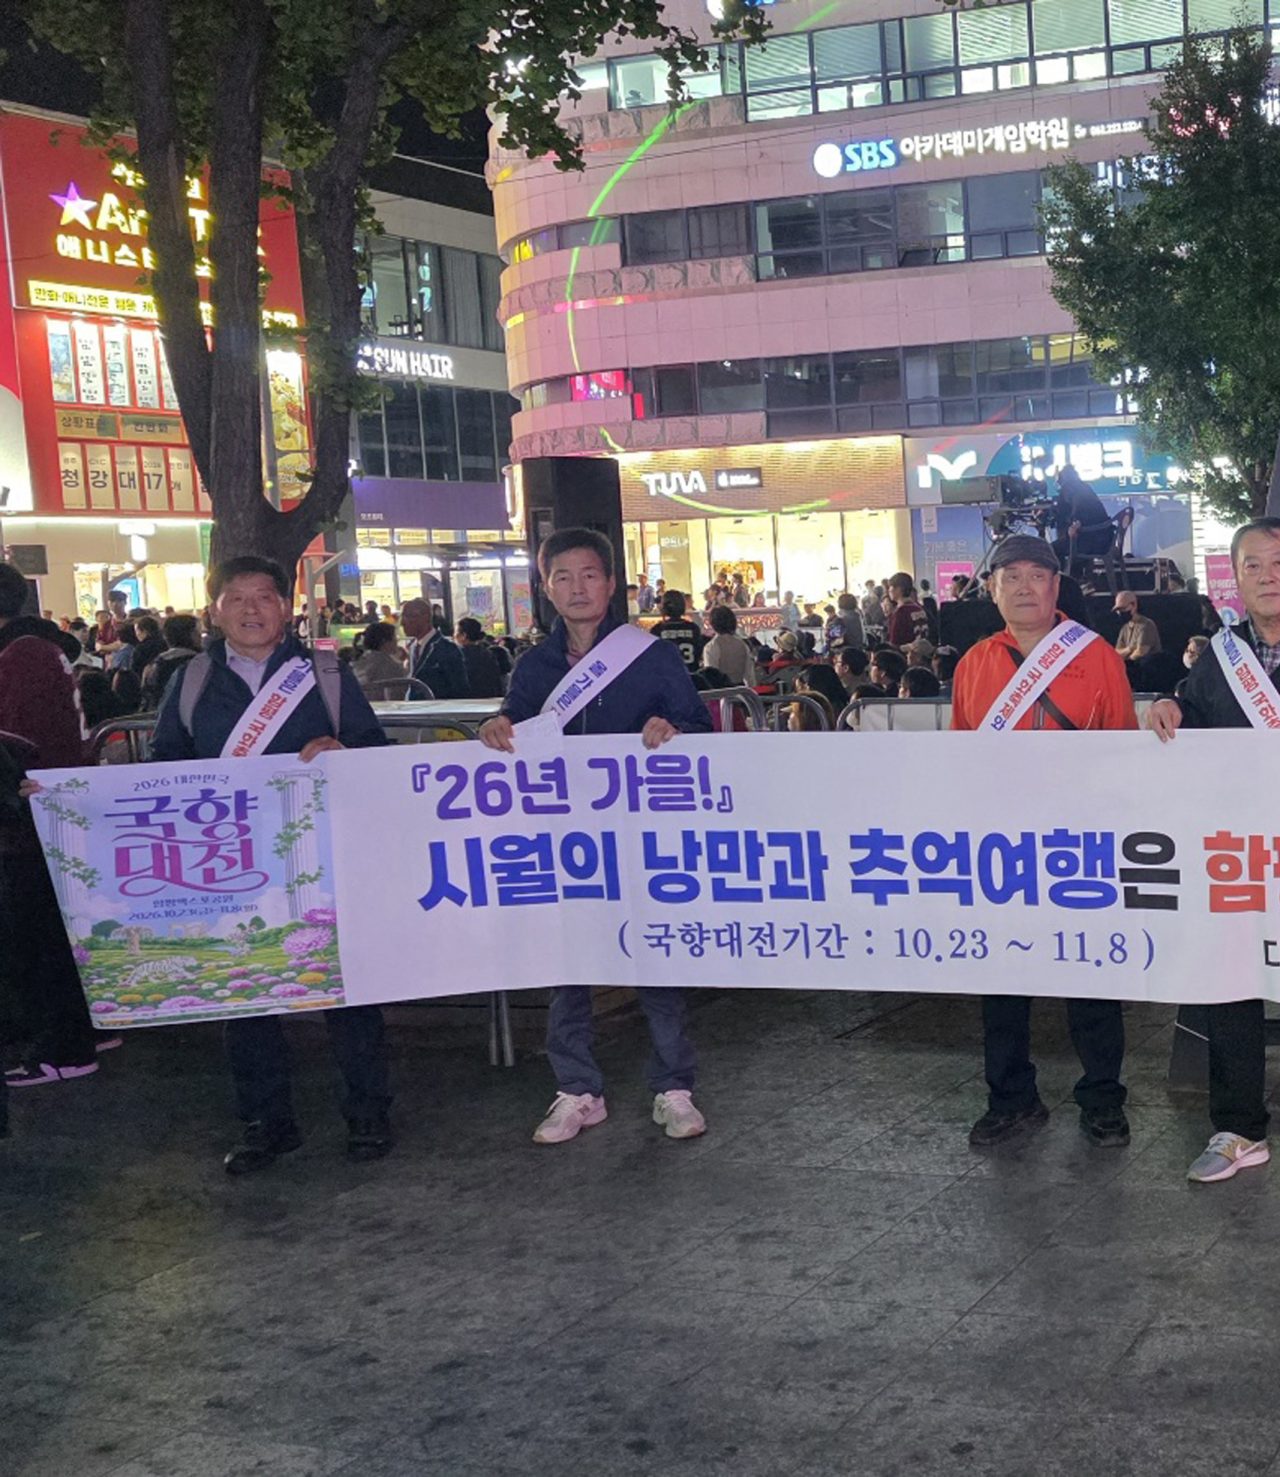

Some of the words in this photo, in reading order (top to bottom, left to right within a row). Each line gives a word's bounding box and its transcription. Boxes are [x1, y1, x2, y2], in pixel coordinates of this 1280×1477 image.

[844, 139, 896, 171] SBS
[899, 117, 1070, 162] 아카데미게임학원
[409, 351, 454, 379] HAIR
[640, 471, 706, 496] TUVA
[1040, 643, 1062, 666] 함평
[557, 673, 593, 712] 가을은
[1235, 663, 1259, 691] 함평
[262, 692, 287, 720] 함평
[991, 667, 1041, 731] 국화축제와
[133, 777, 170, 792] 2026
[174, 774, 230, 786] 대한민국
[412, 756, 571, 820] 『26년
[587, 754, 734, 812] 가을!』
[104, 788, 259, 844] 국향
[114, 838, 270, 897] 대전
[418, 831, 621, 911] 시월의
[642, 830, 829, 903] 낭만과
[849, 828, 1180, 911] 추억여행은
[643, 921, 849, 958] 국향대전기간
[894, 928, 989, 963] 10.23
[1052, 930, 1129, 967] 11.8
